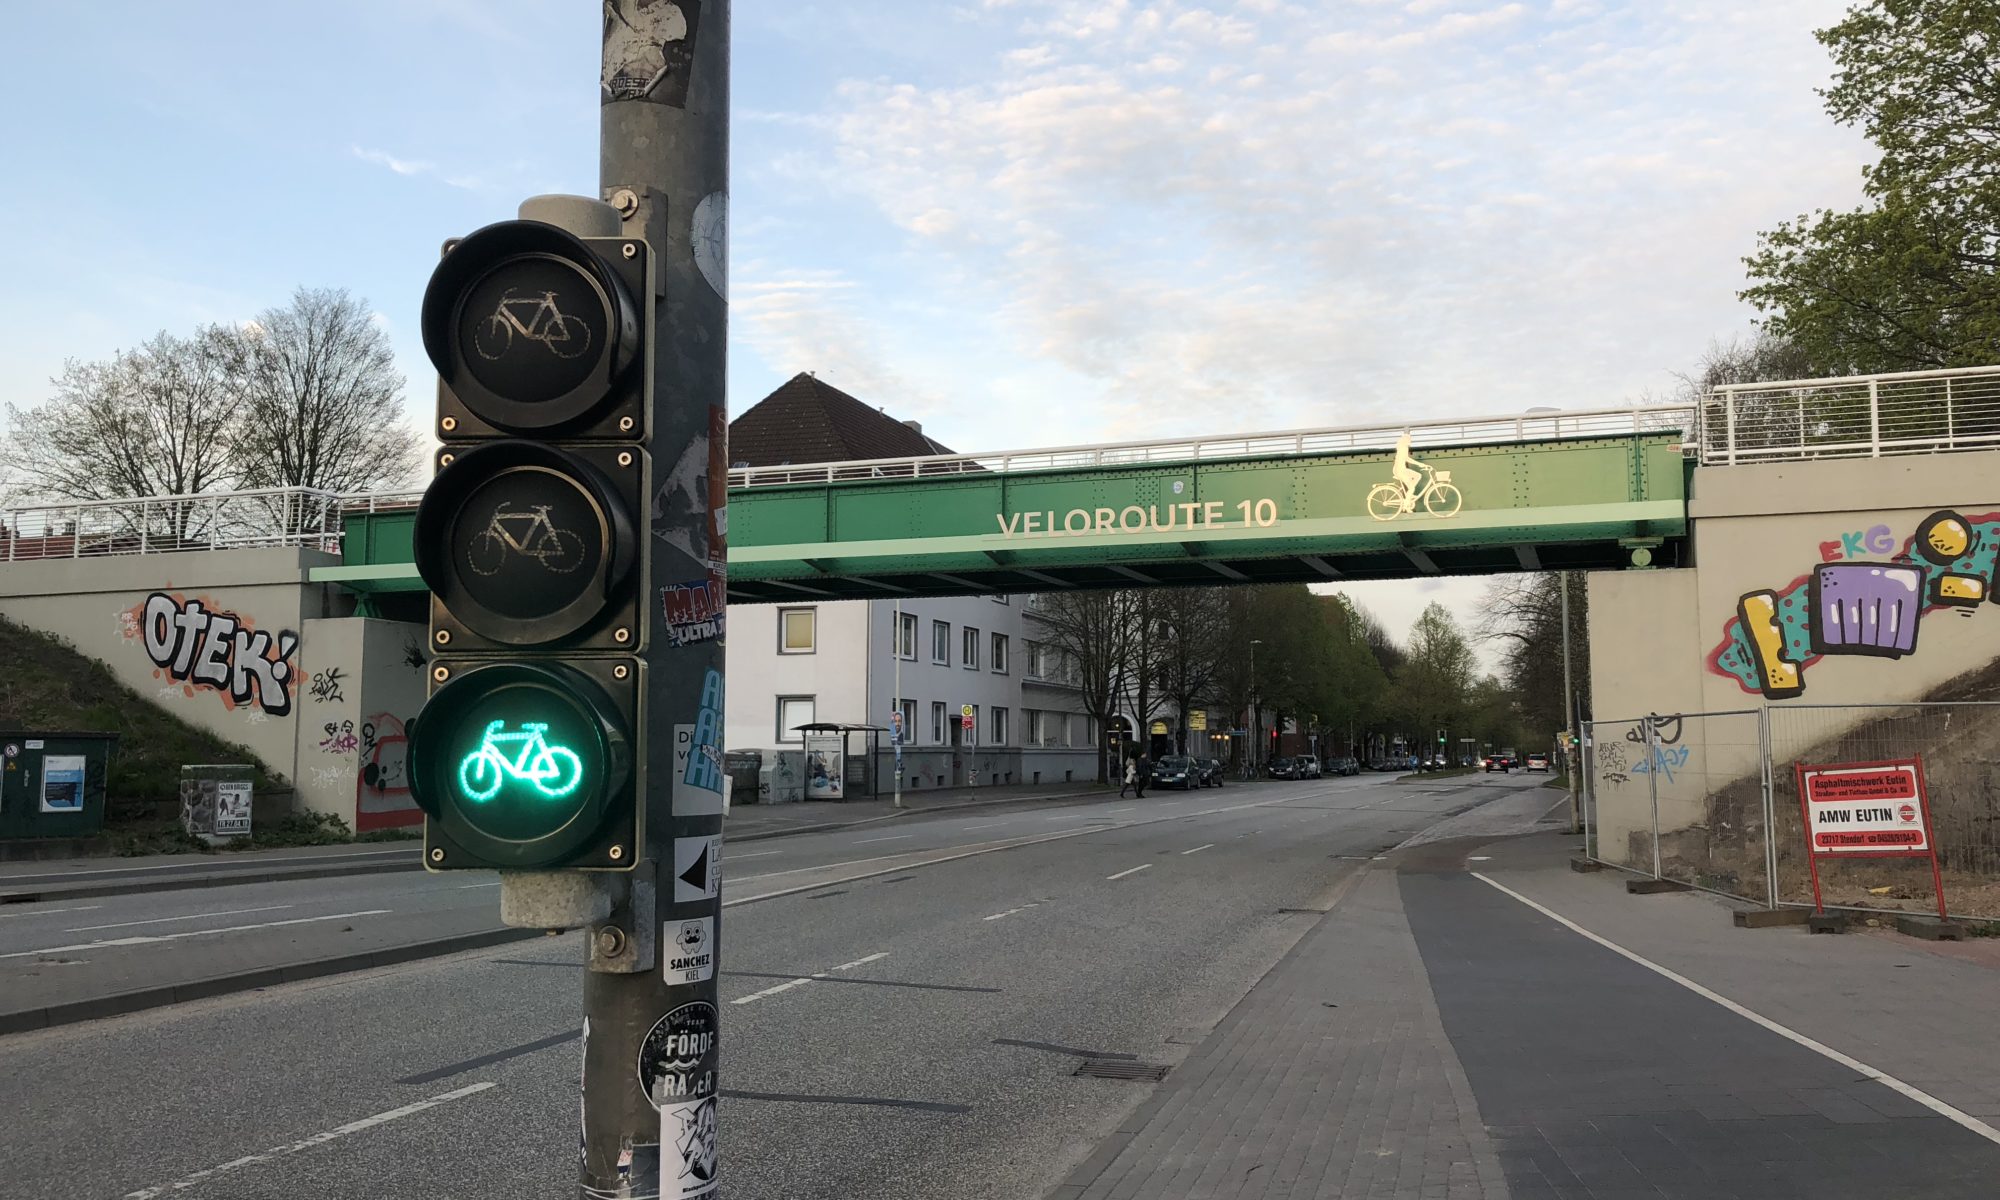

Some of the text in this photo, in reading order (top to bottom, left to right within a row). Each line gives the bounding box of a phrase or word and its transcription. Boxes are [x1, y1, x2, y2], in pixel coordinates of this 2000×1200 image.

[996, 498, 1278, 539] VELOROUTE 10
[1818, 524, 1895, 563] EKG
[678, 620, 718, 643] ULTRA
[1815, 775, 1907, 789] Asphaltmischwerk Eutin
[1819, 807, 1893, 823] AMW EUTIN
[1822, 834, 1839, 844] 23717
[670, 953, 710, 970] SANCHEZ
[685, 968, 700, 982] KIEL
[666, 1029, 714, 1057] FÖRDE
